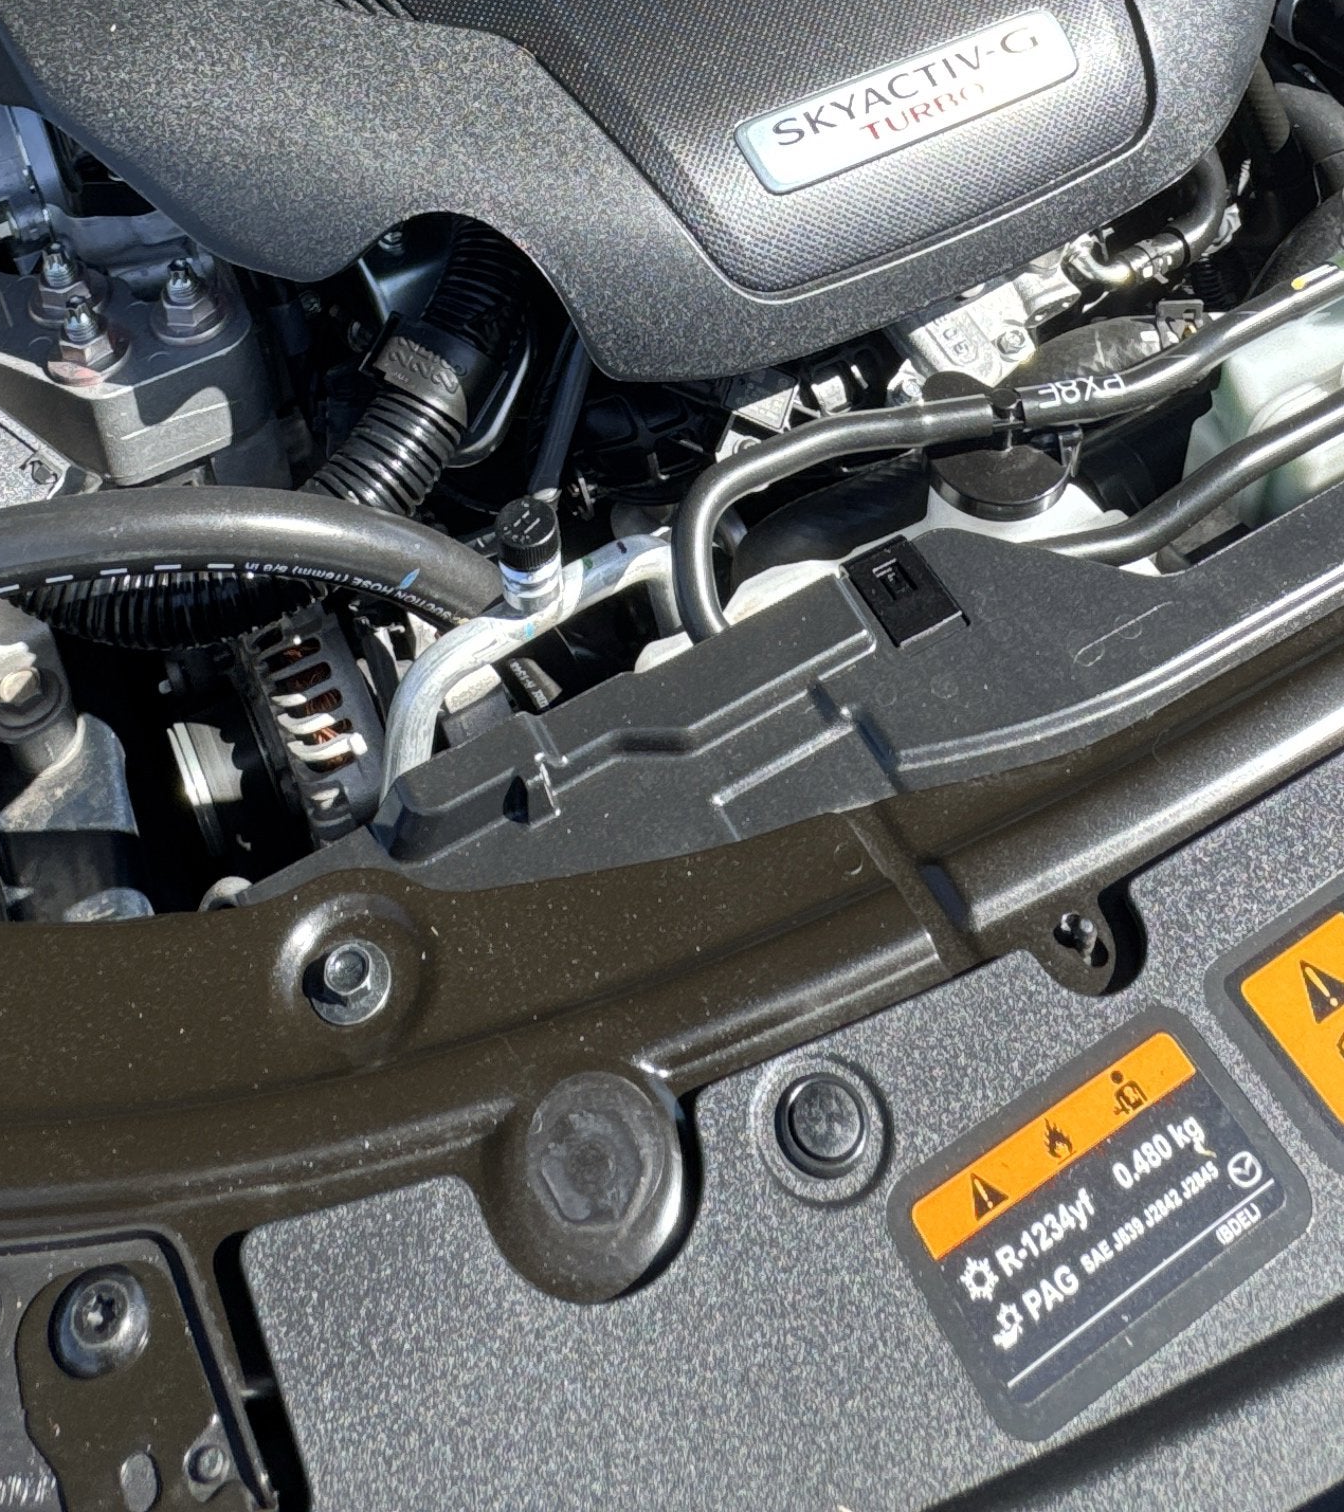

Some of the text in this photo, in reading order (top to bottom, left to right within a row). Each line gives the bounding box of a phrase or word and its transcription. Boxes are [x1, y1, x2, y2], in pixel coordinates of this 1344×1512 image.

[772, 27, 1039, 146] SKYACTIV-G
[860, 83, 985, 140] TURBO
[352, 577, 395, 596] HOSE
[995, 1116, 1206, 1278] R-1234yf 0.480 kg
[1215, 1202, 1263, 1246] (BDEL)
[1021, 1265, 1079, 1322] PAG
[1079, 1240, 1114, 1275] SAE
